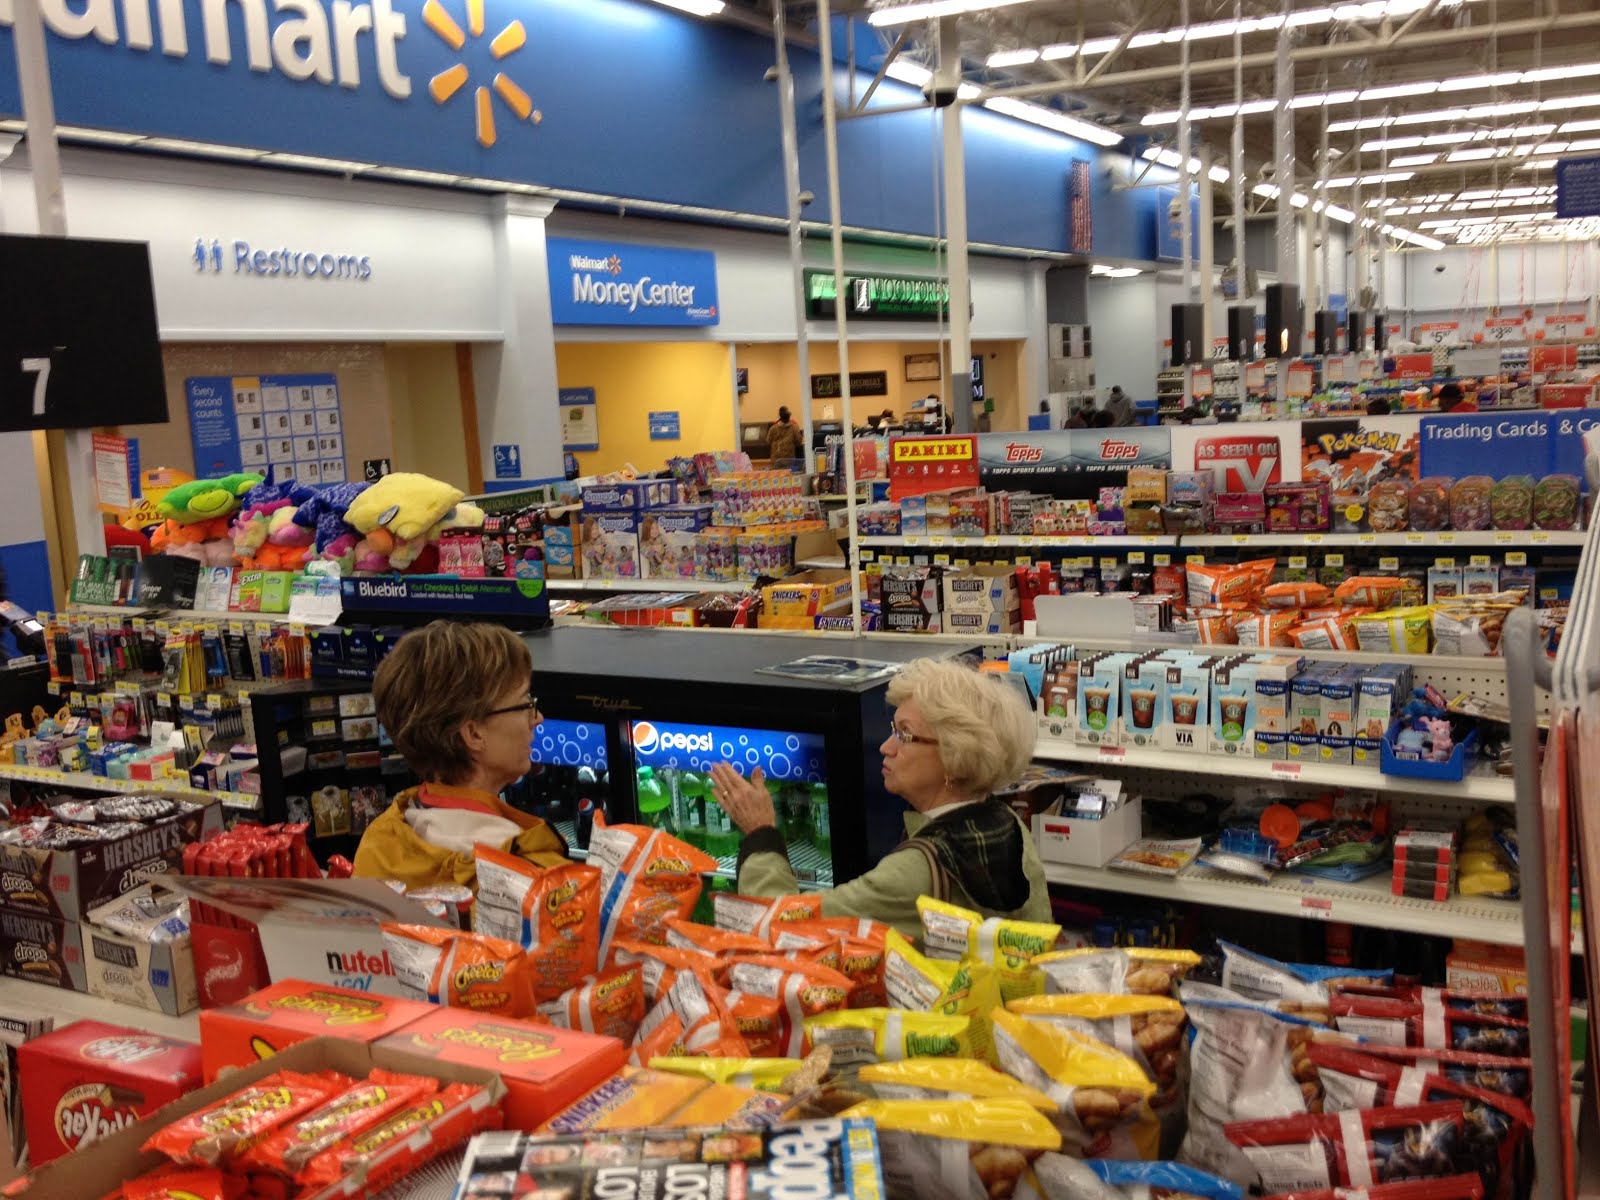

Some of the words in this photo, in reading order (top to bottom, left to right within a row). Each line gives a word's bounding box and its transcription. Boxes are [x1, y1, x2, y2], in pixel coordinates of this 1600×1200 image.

[234, 242, 371, 279] Restrooms
[571, 255, 609, 271] Walmart
[573, 273, 695, 313] MoneyCenter
[21, 358, 51, 415] 7
[192, 385, 215, 399] Every
[194, 397, 223, 408] second
[195, 409, 224, 419] counts.
[1425, 422, 1493, 442] Trading
[1497, 421, 1548, 437] Cards
[1560, 419, 1574, 434] &
[899, 443, 968, 457] PANINI
[1199, 445, 1216, 457] AS
[1220, 443, 1253, 456] SEEN
[1258, 443, 1278, 455] ON
[992, 467, 1011, 475] TOPPS
[1199, 457, 1278, 492] TV
[598, 516, 634, 530] Snuggie
[659, 516, 695, 530] Snuggie
[242, 572, 262, 585] Extra
[953, 580, 984, 591] HERSHEY'S
[359, 581, 407, 598] Bluebird
[883, 580, 917, 592] HERSHEY'S
[771, 590, 801, 599] SNICKERS
[819, 618, 853, 629] SNICKERS
[888, 614, 923, 626] HERSHEY'S
[951, 615, 982, 626] HERSHEY'S
[661, 732, 713, 753] pepsi
[1176, 732, 1194, 743] VIA
[103, 820, 180, 872] HERSHEY'S
[644, 858, 692, 877] Cheetos
[2, 872, 33, 892] drops
[120, 859, 168, 894] drops
[946, 937, 967, 946] Facts
[15, 940, 48, 962] drops
[454, 961, 503, 992] Cheetos
[751, 1118, 844, 1200] Peop
